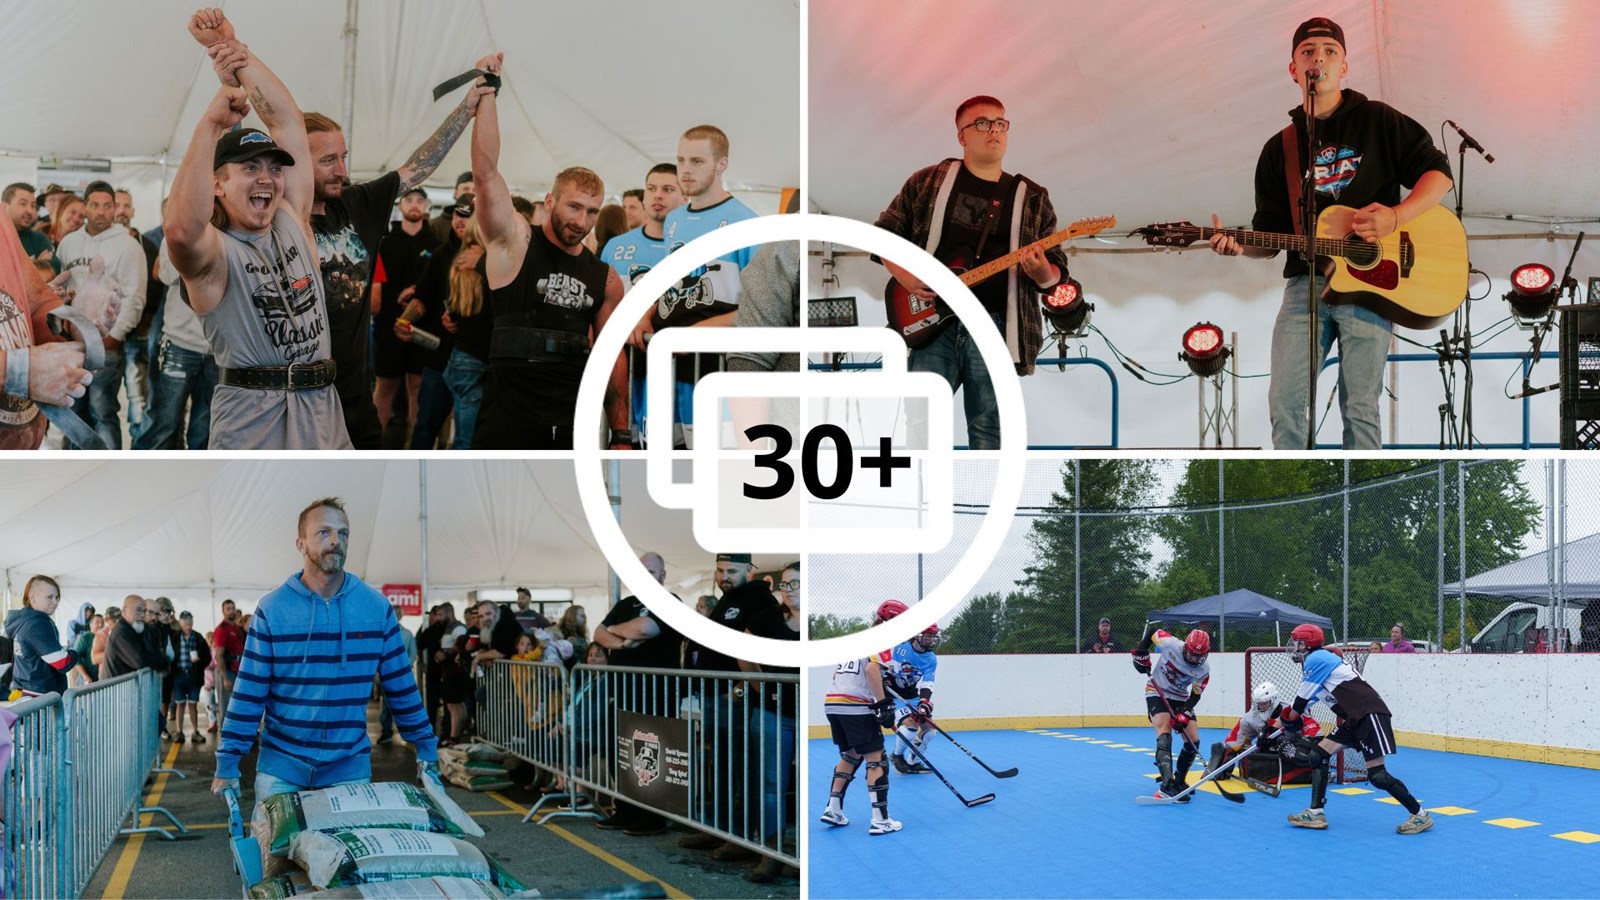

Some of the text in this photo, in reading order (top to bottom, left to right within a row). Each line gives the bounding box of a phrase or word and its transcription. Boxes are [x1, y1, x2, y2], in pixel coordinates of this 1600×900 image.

[614, 245, 636, 260] 22
[547, 272, 587, 299] BEAST
[388, 590, 419, 606] ami
